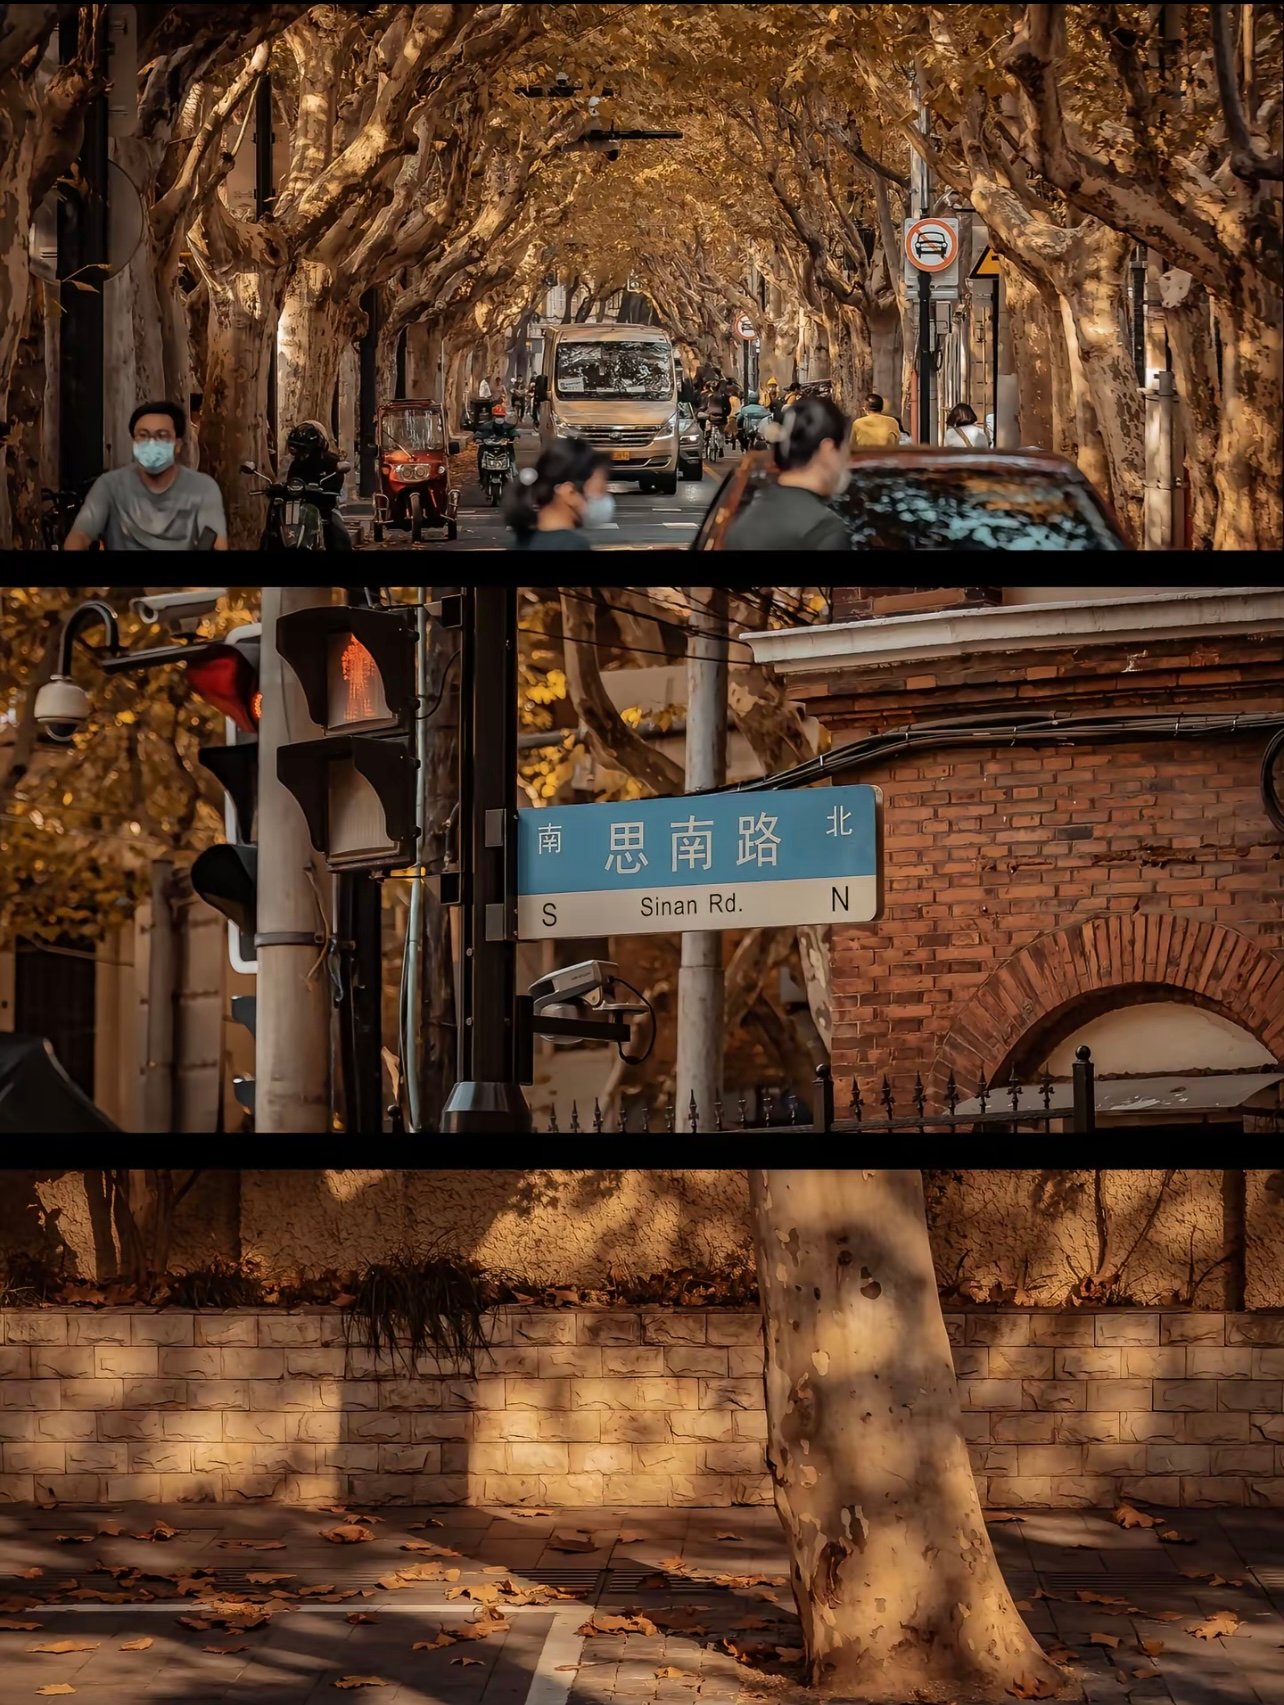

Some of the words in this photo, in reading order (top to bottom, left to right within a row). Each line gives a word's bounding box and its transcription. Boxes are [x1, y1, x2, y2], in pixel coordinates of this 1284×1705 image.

[826, 805, 853, 837] 北
[537, 822, 562, 855] 南
[604, 811, 782, 874] 思南路
[640, 892, 697, 917] Sinan
[709, 892, 743, 914] Rd.
[831, 886, 849, 912] N
[541, 902, 558, 927] S
